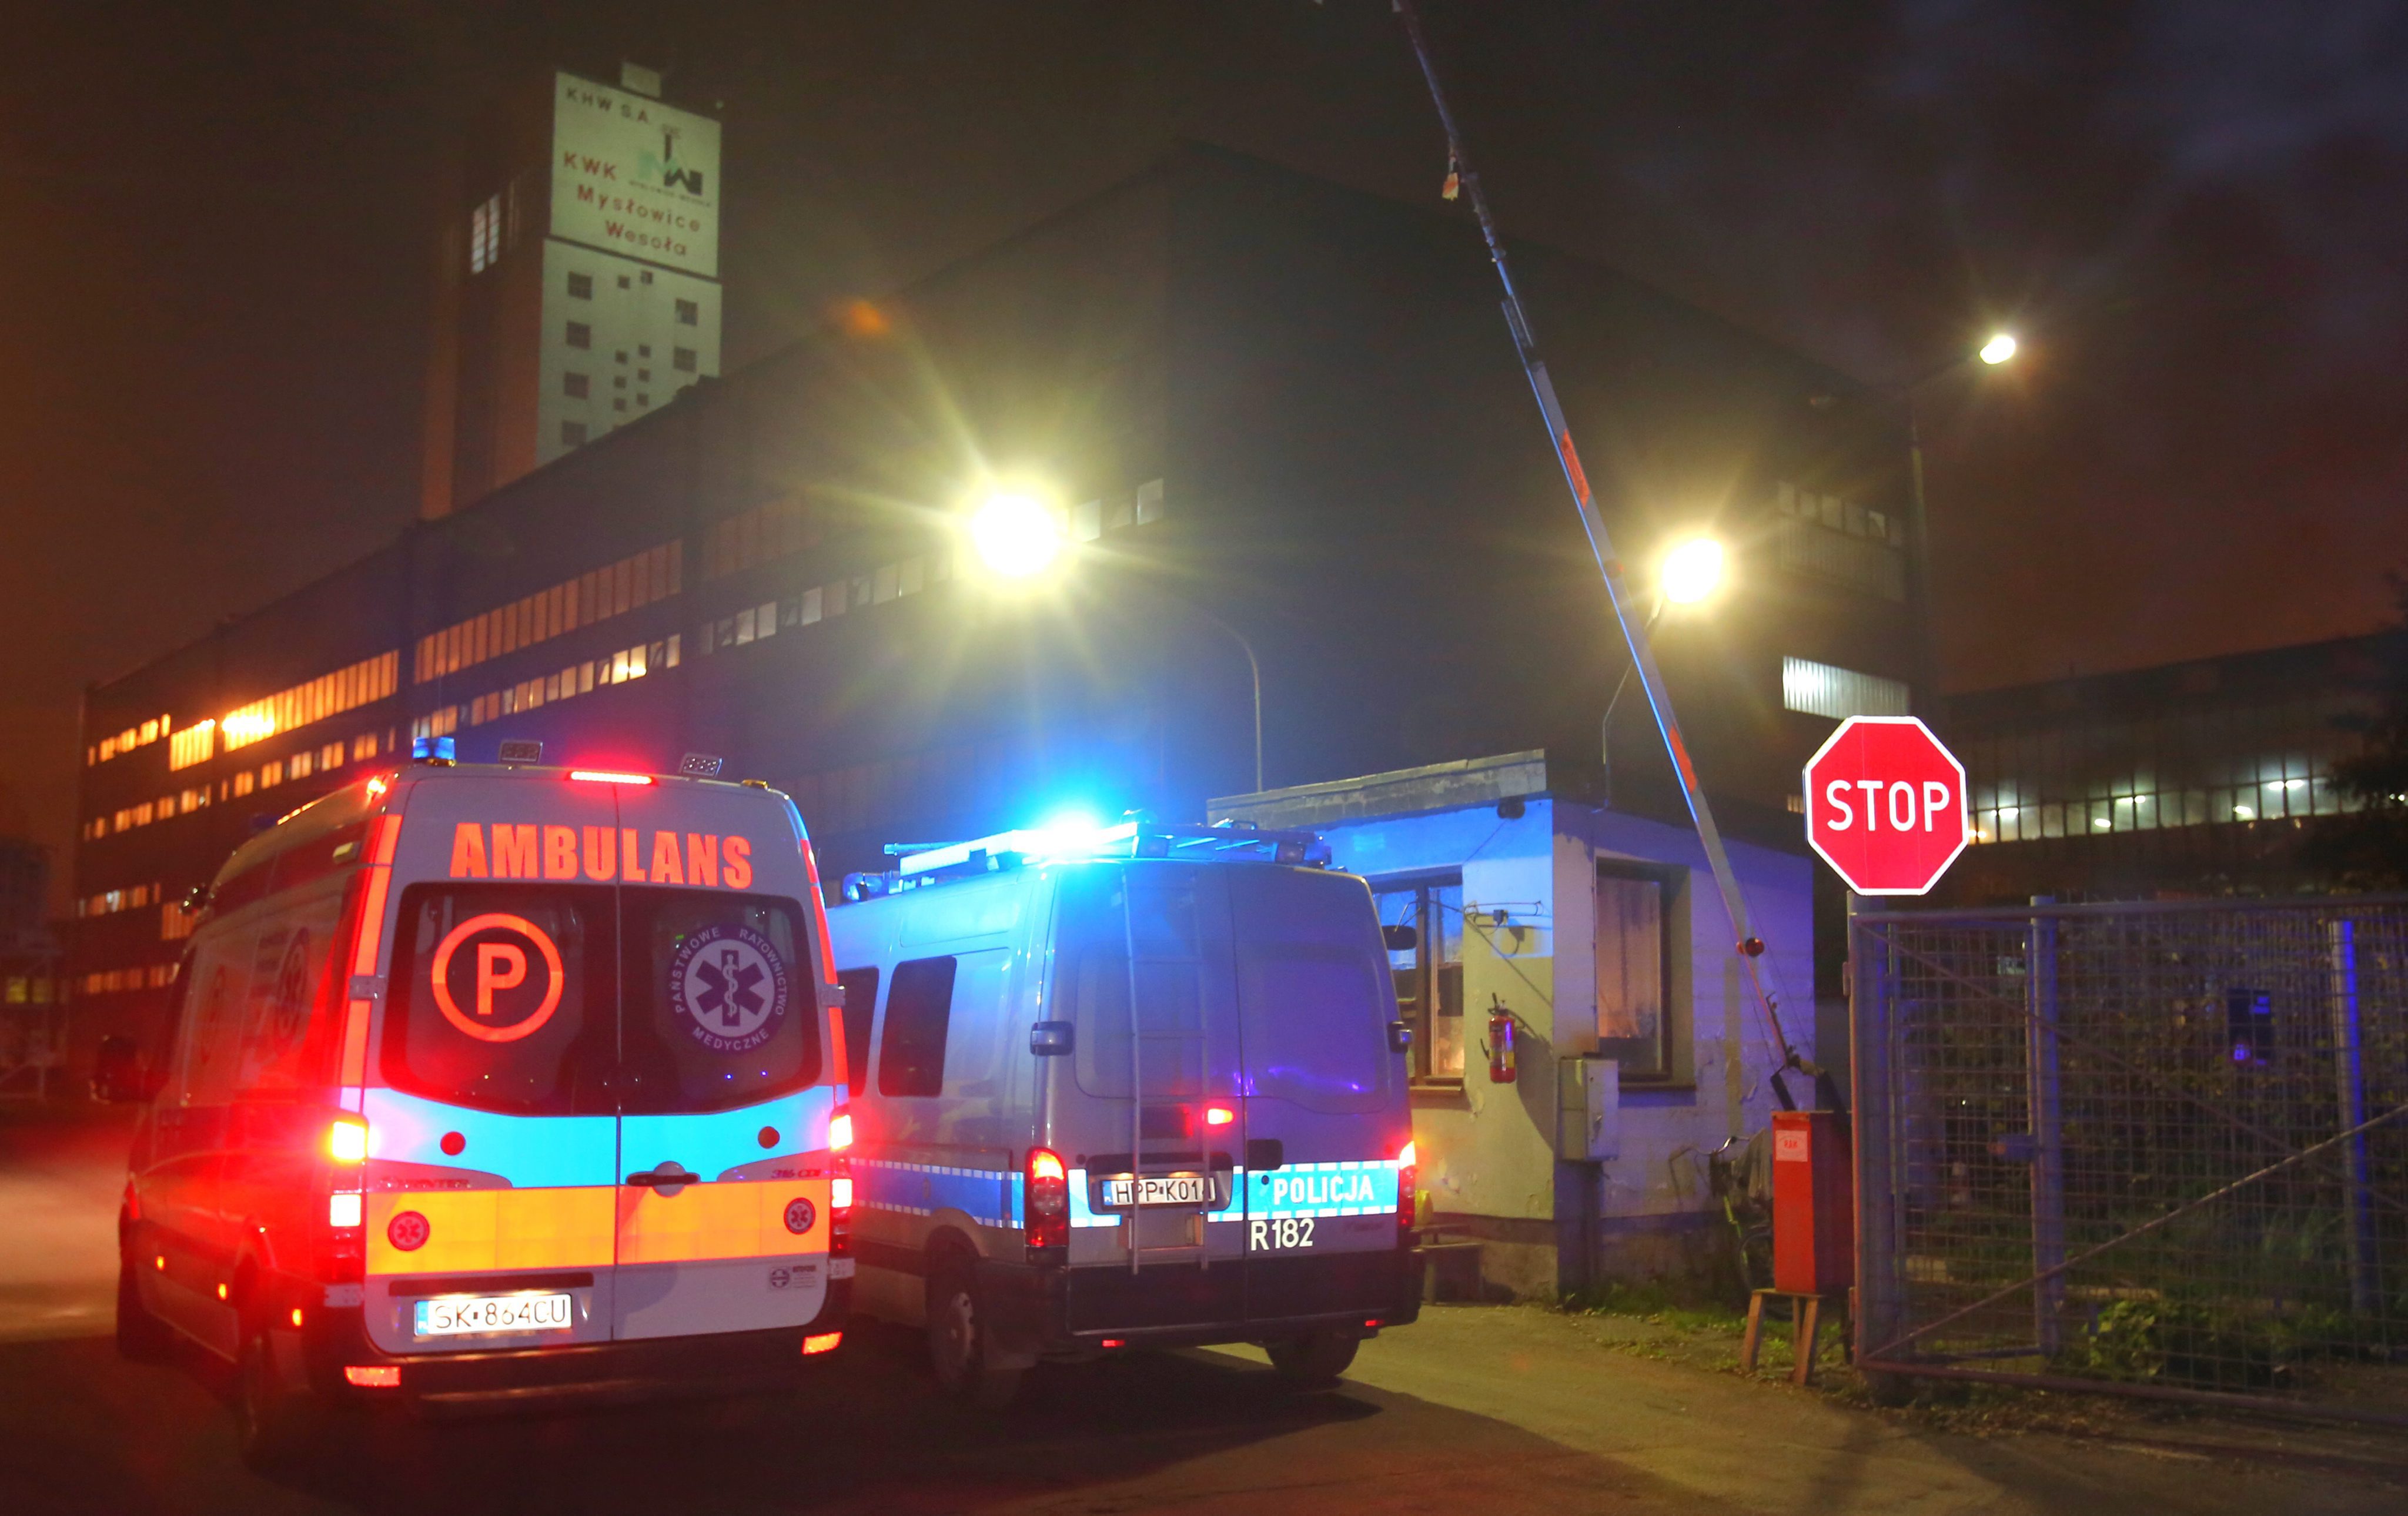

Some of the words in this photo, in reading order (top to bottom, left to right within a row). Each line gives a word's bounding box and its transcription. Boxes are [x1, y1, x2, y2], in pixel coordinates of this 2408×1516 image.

[566, 88, 613, 112] KHW
[563, 150, 617, 180] KWK
[577, 184, 701, 232] Mysłowice
[605, 220, 687, 255] Wesoła
[1826, 779, 1950, 832] STOP
[449, 822, 753, 889] AMBULANS
[476, 943, 527, 1015] P
[739, 928, 788, 1016] RATOWNICTWO
[692, 1026, 769, 1051] MEDYCZNE
[1273, 1176, 1374, 1205] POLICJA
[435, 1304, 471, 1328] SK
